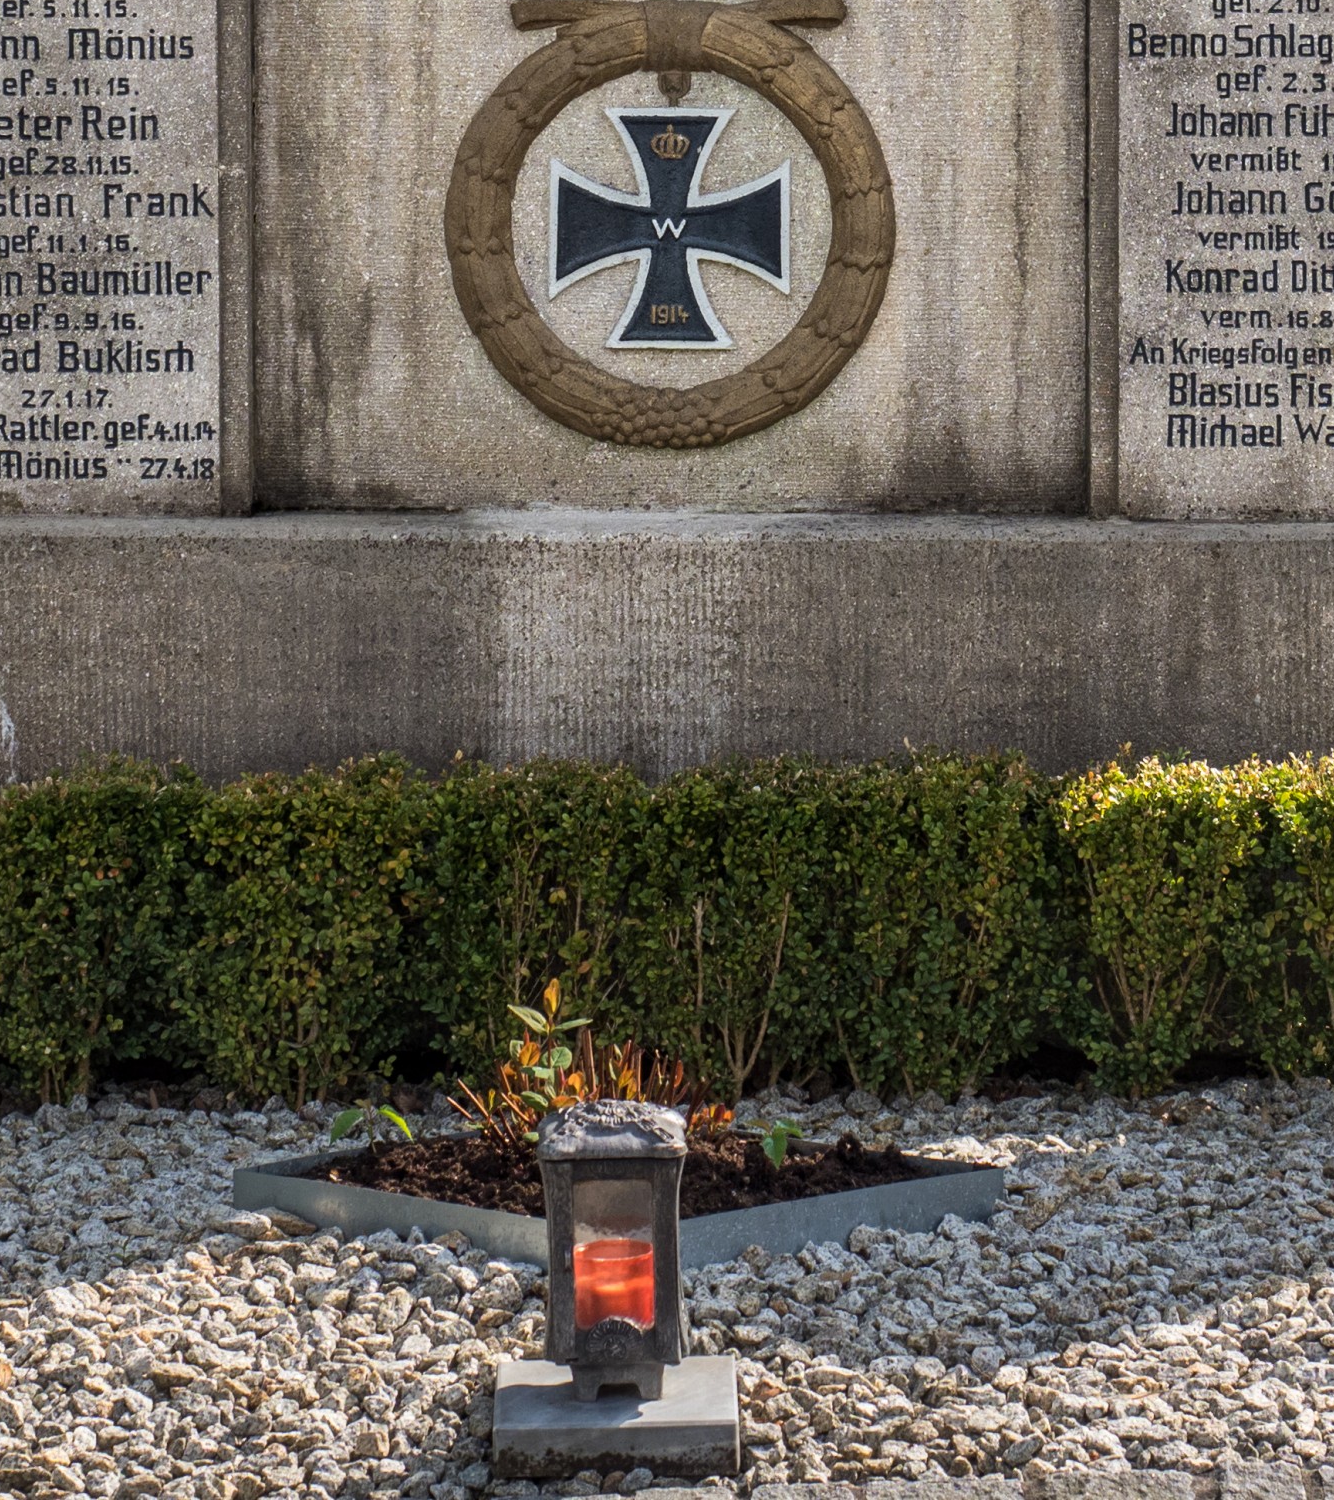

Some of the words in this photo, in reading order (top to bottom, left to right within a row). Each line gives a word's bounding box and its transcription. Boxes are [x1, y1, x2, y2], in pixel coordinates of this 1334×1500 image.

[68, 28, 193, 60] Mönius
[1129, 24, 1226, 58] Benno
[82, 105, 158, 141] Rein
[1166, 103, 1273, 137] Johann
[104, 184, 213, 218] Frank
[1172, 182, 1286, 217] Johann
[652, 218, 686, 239] W
[37, 261, 211, 295] Baumüller
[1166, 260, 1278, 295] Konrad
[650, 304, 689, 325] 1914
[1130, 337, 1164, 364] An
[1171, 338, 1333, 369] Kriegsfolgen
[1169, 372, 1278, 408] Blasius
